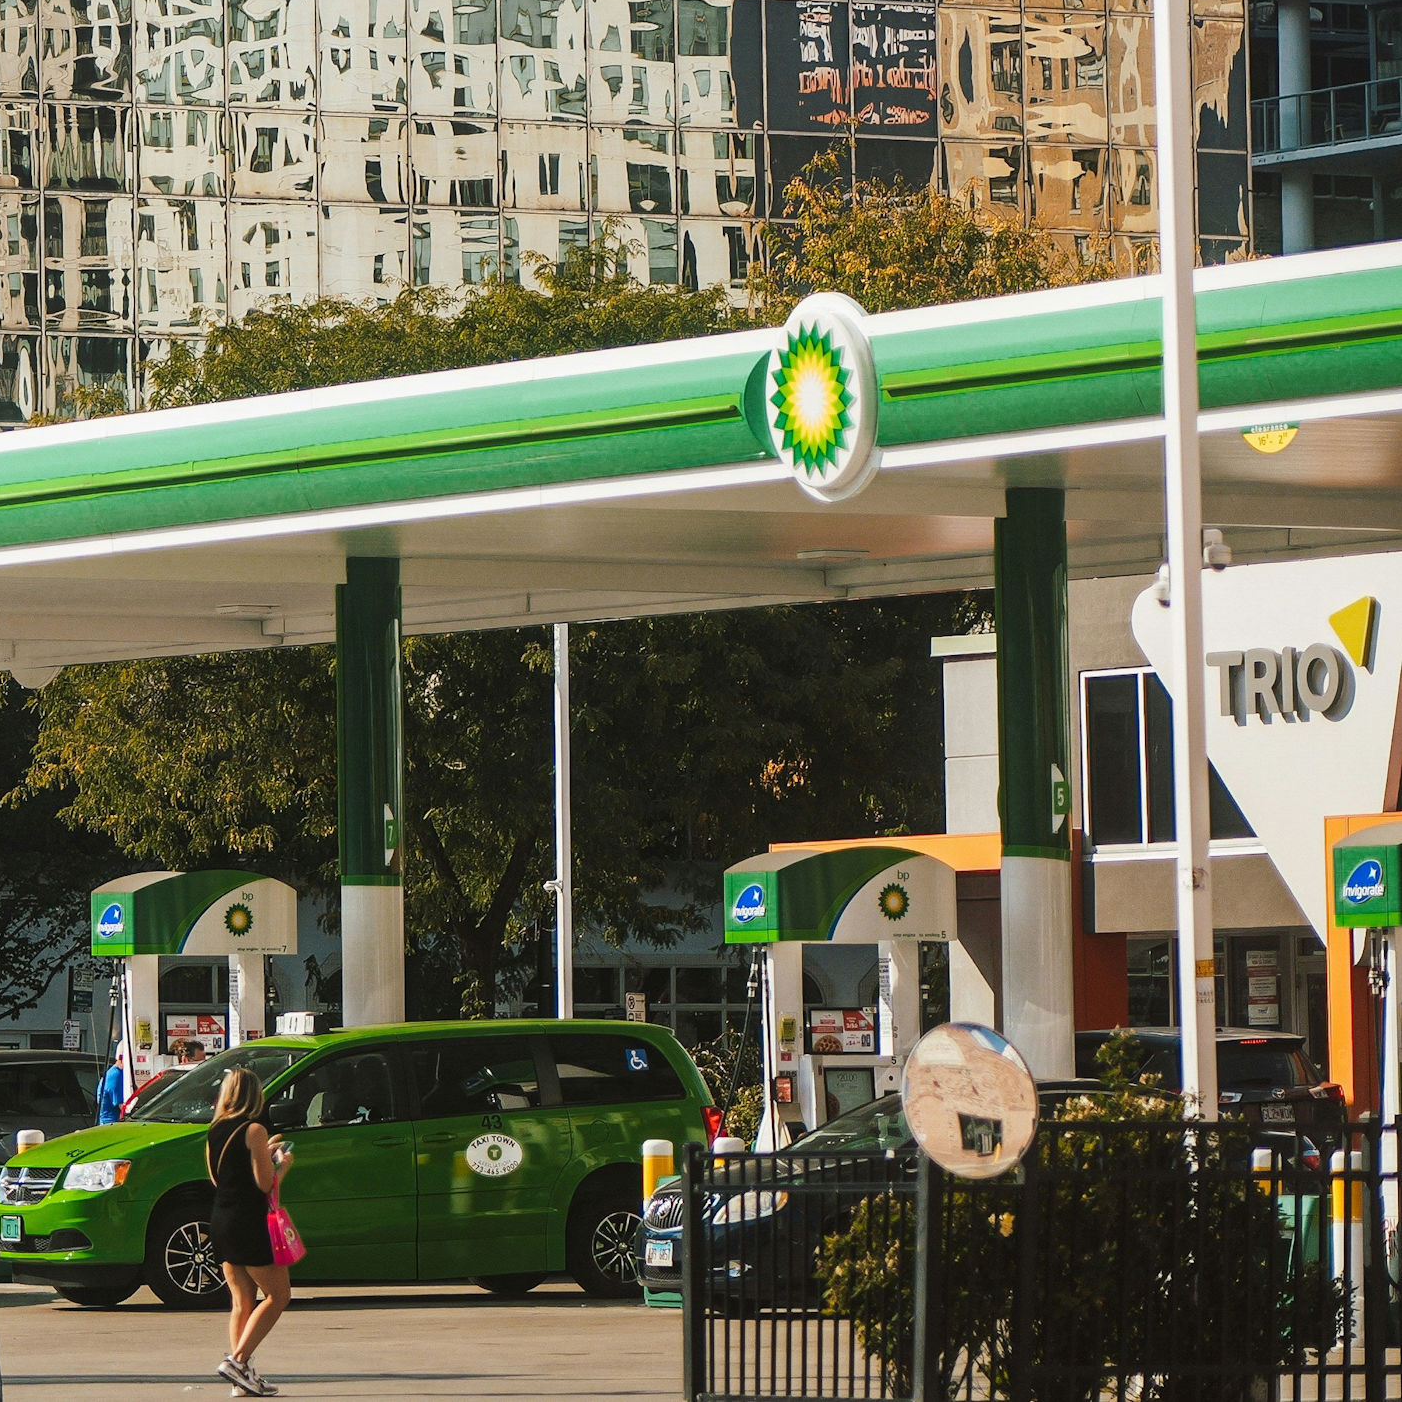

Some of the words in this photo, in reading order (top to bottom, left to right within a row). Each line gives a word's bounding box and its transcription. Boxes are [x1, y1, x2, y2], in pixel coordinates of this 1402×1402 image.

[1251, 423, 1289, 434] clearance
[1206, 643, 1342, 716] TRIO
[1057, 787, 1065, 806] 5
[388, 825, 393, 842] 7
[897, 869, 910, 881] bp
[242, 891, 254, 901] bp
[1342, 884, 1384, 899] Invigorate
[732, 905, 766, 919] Invigorate
[941, 930, 946, 939] 5
[481, 1114, 503, 1130] 43
[471, 1136, 490, 1149] TAXI
[491, 1135, 516, 1148] TOWN
